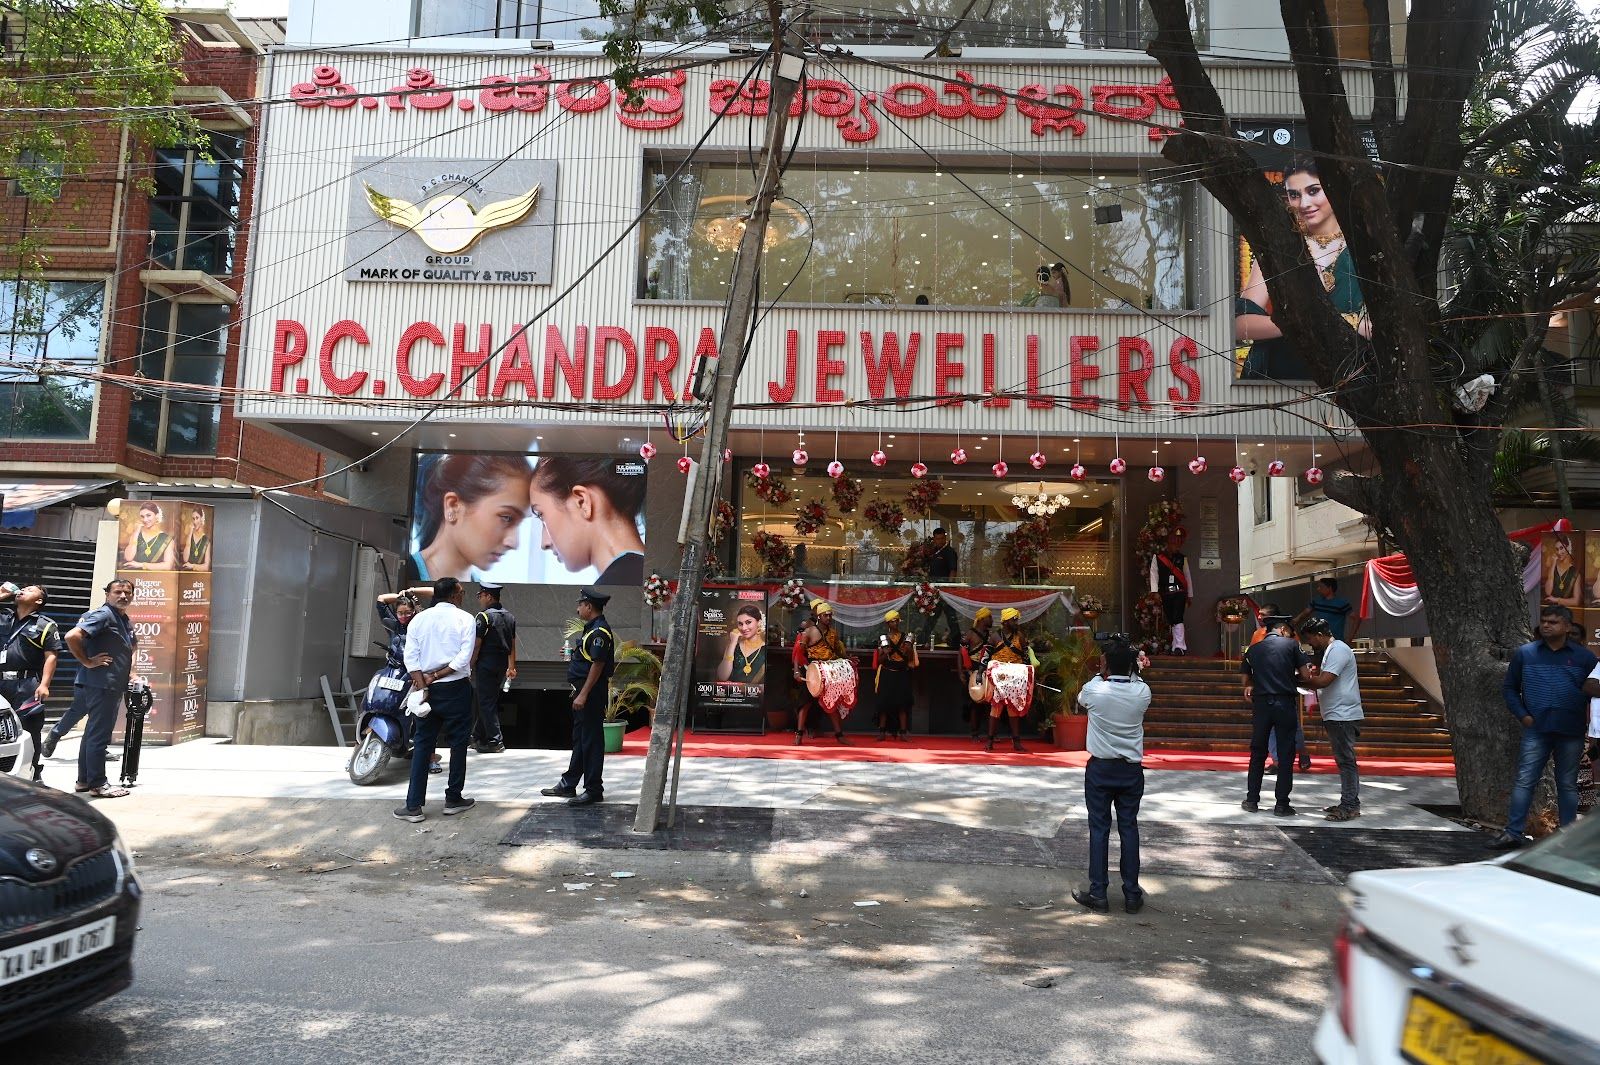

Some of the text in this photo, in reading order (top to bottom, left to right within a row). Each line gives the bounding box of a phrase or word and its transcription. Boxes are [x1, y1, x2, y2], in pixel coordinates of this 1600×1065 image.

[425, 255, 471, 265] GROUP
[360, 268, 537, 283] MARK OF QUALITY & TRUST
[767, 328, 1202, 412] JEWELLERS
[135, 578, 162, 589] Bigger
[132, 588, 165, 601] pace
